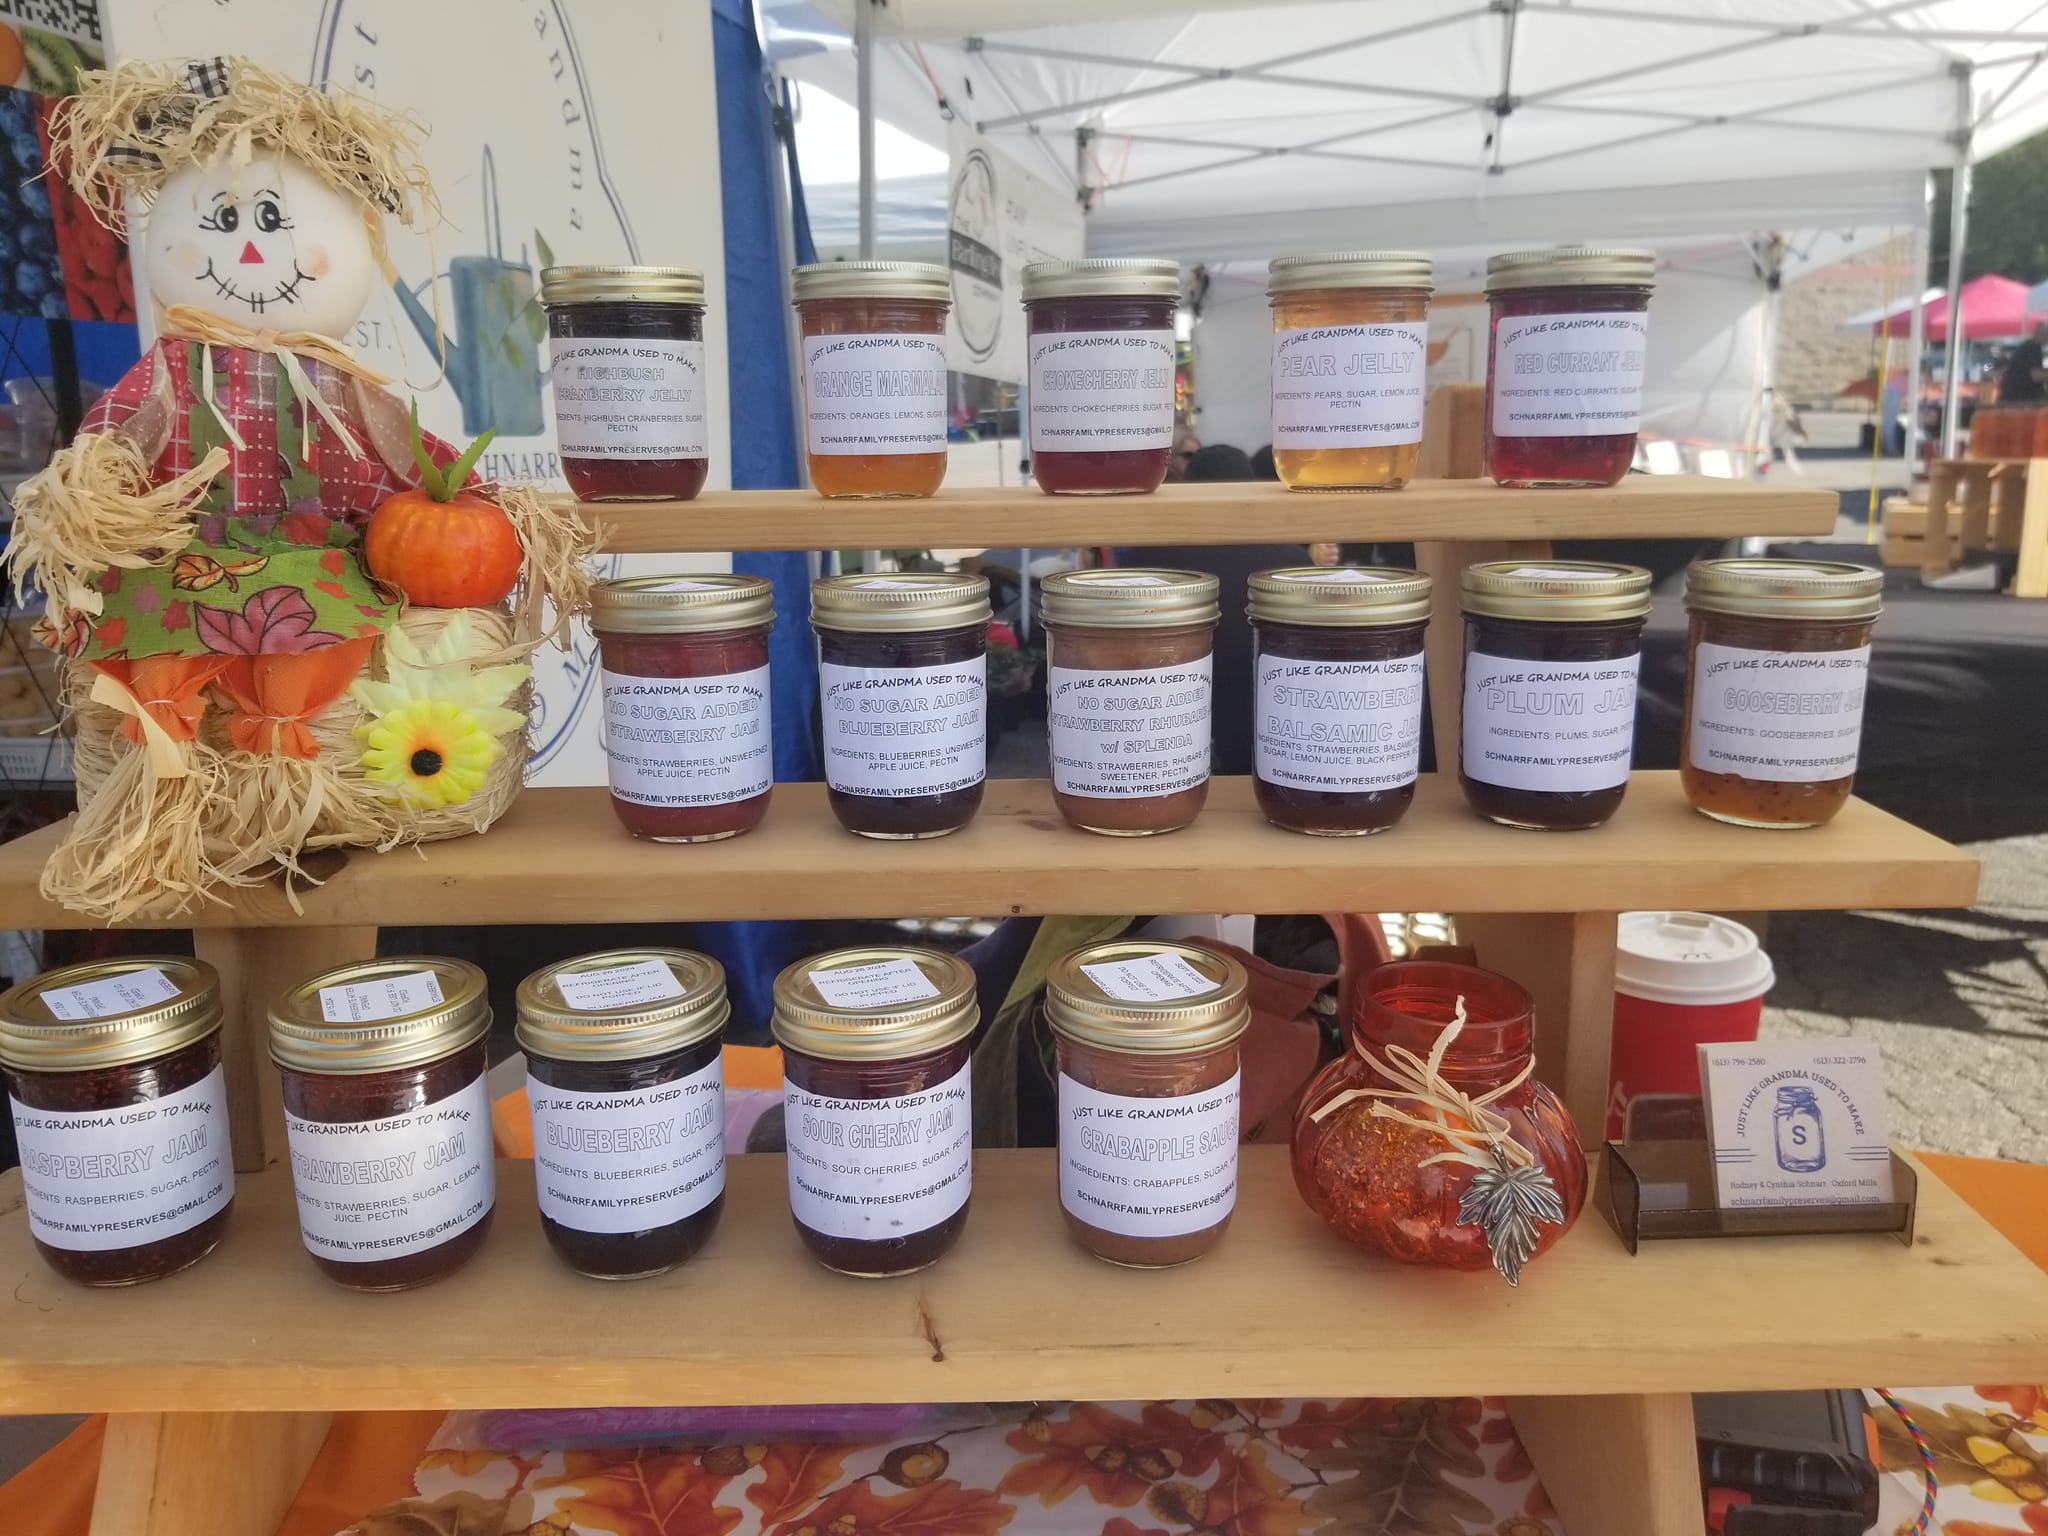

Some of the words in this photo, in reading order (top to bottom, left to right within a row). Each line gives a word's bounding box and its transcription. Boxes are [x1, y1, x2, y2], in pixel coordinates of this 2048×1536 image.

[342, 321, 392, 350] ST.
[1291, 333, 1309, 345] LIKE
[1311, 328, 1365, 340] GRANDMA
[1369, 329, 1393, 337] USED
[1397, 330, 1408, 338] TO
[810, 348, 824, 366] JUST
[826, 343, 845, 354] LIKE
[848, 339, 900, 349] GRANDMA
[903, 340, 924, 348] USED
[927, 343, 935, 351] TO
[1515, 354, 1543, 374] RED
[1547, 352, 1620, 374] CURRANT
[577, 367, 664, 380] HIGHBUSH
[1280, 356, 1336, 378] PEAR
[1344, 352, 1415, 376] JELLY
[815, 371, 872, 398] ORANGE
[1043, 370, 1139, 391] CHOKECHERRY
[1141, 369, 1169, 389] JELLY
[650, 389, 692, 402] JELLY
[483, 451, 560, 481] HNARR
[1707, 662, 1730, 677] JUST
[1734, 660, 1759, 669] LIKE
[1762, 659, 1826, 668] GRANDMA
[1829, 659, 1851, 667] USED
[826, 684, 840, 700] JUST
[843, 680, 862, 691] LIKE
[865, 678, 922, 688] GRANDMA
[926, 675, 951, 684] USED
[955, 675, 966, 683] TO
[1056, 682, 1071, 698] JUST
[1074, 679, 1094, 689] LIKE
[1098, 676, 1156, 687] GRANDMA
[1160, 674, 1185, 683] USED
[1477, 677, 1496, 692] JUST
[1500, 674, 1524, 683] LIKE
[1528, 672, 1590, 682] GRANDMA
[1594, 671, 1618, 680] USED
[1621, 671, 1629, 679] TO
[631, 704, 696, 721] SUGAR
[701, 698, 758, 719] ADDED
[834, 696, 855, 711] NO
[860, 697, 928, 713] SUGAR
[933, 686, 981, 709] ADDED
[1078, 697, 1099, 710] NO
[1104, 697, 1162, 711] SUGAR
[1166, 687, 1205, 708] ADDED
[1487, 688, 1583, 716] PLUM
[1724, 688, 1843, 715] GOOSEBERRY
[610, 722, 726, 743] STRAWBERRY
[731, 719, 759, 738] JAM
[839, 718, 947, 736] BLUEBERRY
[952, 709, 980, 728] JAM
[1268, 716, 1393, 743] BALSAMIC
[1489, 727, 1552, 740] INGREDIENTS:
[1555, 732, 1590, 740] PLUMS,
[1101, 741, 1119, 753] w/
[1123, 734, 1193, 753] SPLENDA
[1306, 745, 1381, 754] STRAWBERRIES,
[642, 758, 718, 768] STRAWBERRIES,
[869, 761, 896, 771] APPLE
[899, 762, 928, 771] JUICE,
[930, 756, 959, 767] PECTIN
[1097, 761, 1170, 771] STRAWBERRIES,
[1291, 753, 1321, 763] LEMON
[637, 768, 663, 778] APPLE
[698, 767, 730, 777] PECTIN
[835, 769, 984, 796] SCHNARRFAMILYPRESERVES@GMAIL.COM
[1101, 772, 1159, 781] SWEETENER,
[1163, 767, 1189, 778] PECTIN
[614, 780, 768, 803] SCHNARRFAMILYPRESERVES@GMAIL.COM
[1732, 1058, 1766, 1066] 796-2580
[1813, 1057, 1831, 1065] (613)
[1832, 1056, 1867, 1065] 322-2796
[534, 1100, 548, 1114] JUST
[551, 1100, 573, 1110] LIKE
[577, 1097, 645, 1111] GRANDMA
[649, 1089, 681, 1104] USED
[684, 1082, 698, 1096] TO
[700, 1080, 721, 1093] MAKE
[1072, 1107, 1094, 1120] JUST
[1097, 1108, 1123, 1118] LIKE
[1128, 1106, 1194, 1120] GRANDMA
[1197, 1098, 1223, 1112] USED
[1225, 1094, 1233, 1104] TO
[1737, 1111, 1749, 1137] JUST
[1744, 1087, 1760, 1108] LIKE
[1759, 1069, 1809, 1089] GRANDMA
[1811, 1073, 1837, 1091] USED
[1838, 1089, 1850, 1103] TO
[1848, 1105, 1864, 1136] MAKE
[24, 1118, 42, 1128] LIKE
[45, 1117, 115, 1130] GRANDMA
[120, 1111, 157, 1125] USED
[161, 1105, 178, 1118] TO
[182, 1102, 212, 1115] MAKE
[546, 1118, 675, 1154] BLUEBERRY
[679, 1098, 715, 1137] JAM
[803, 1113, 844, 1148] SOUR
[849, 1118, 922, 1149] CHERRY
[926, 1104, 954, 1139] JAM
[162, 1124, 208, 1164] JAM
[1081, 1125, 1195, 1162] CRABAPPLE
[1792, 1125, 1807, 1145] S
[424, 1132, 466, 1171] JAM
[832, 1164, 861, 1175] SOUR
[864, 1163, 920, 1175] CHERRIES,
[922, 1149, 951, 1166] SUGAR,
[151, 1176, 190, 1195] SUGAR,
[192, 1159, 220, 1182] PECTIN
[594, 1164, 670, 1181] BLUEBERRIES,
[672, 1149, 704, 1168] SUGAR,
[1070, 1160, 1130, 1186] INGREDIENTS:
[1134, 1176, 1201, 1187] CRABAPPLES,
[324, 1196, 411, 1212] STRAWBERRIES,
[413, 1182, 451, 1201] SUGAR,
[454, 1162, 481, 1186] LEMON
[796, 1160, 969, 1205] SCHNARRFAMILYPRESERVES@GMAIL.COM
[1730, 1181, 1757, 1189] Rodney
[1766, 1181, 1795, 1189] Cynthia
[1831, 1179, 1856, 1187] Oxford
[1858, 1179, 1877, 1187] Mills
[1731, 1195, 1880, 1206] schnarrfamilypreserves@gmail.com
[334, 1214, 365, 1224] JUICE,
[368, 1208, 408, 1222] PECTIN
